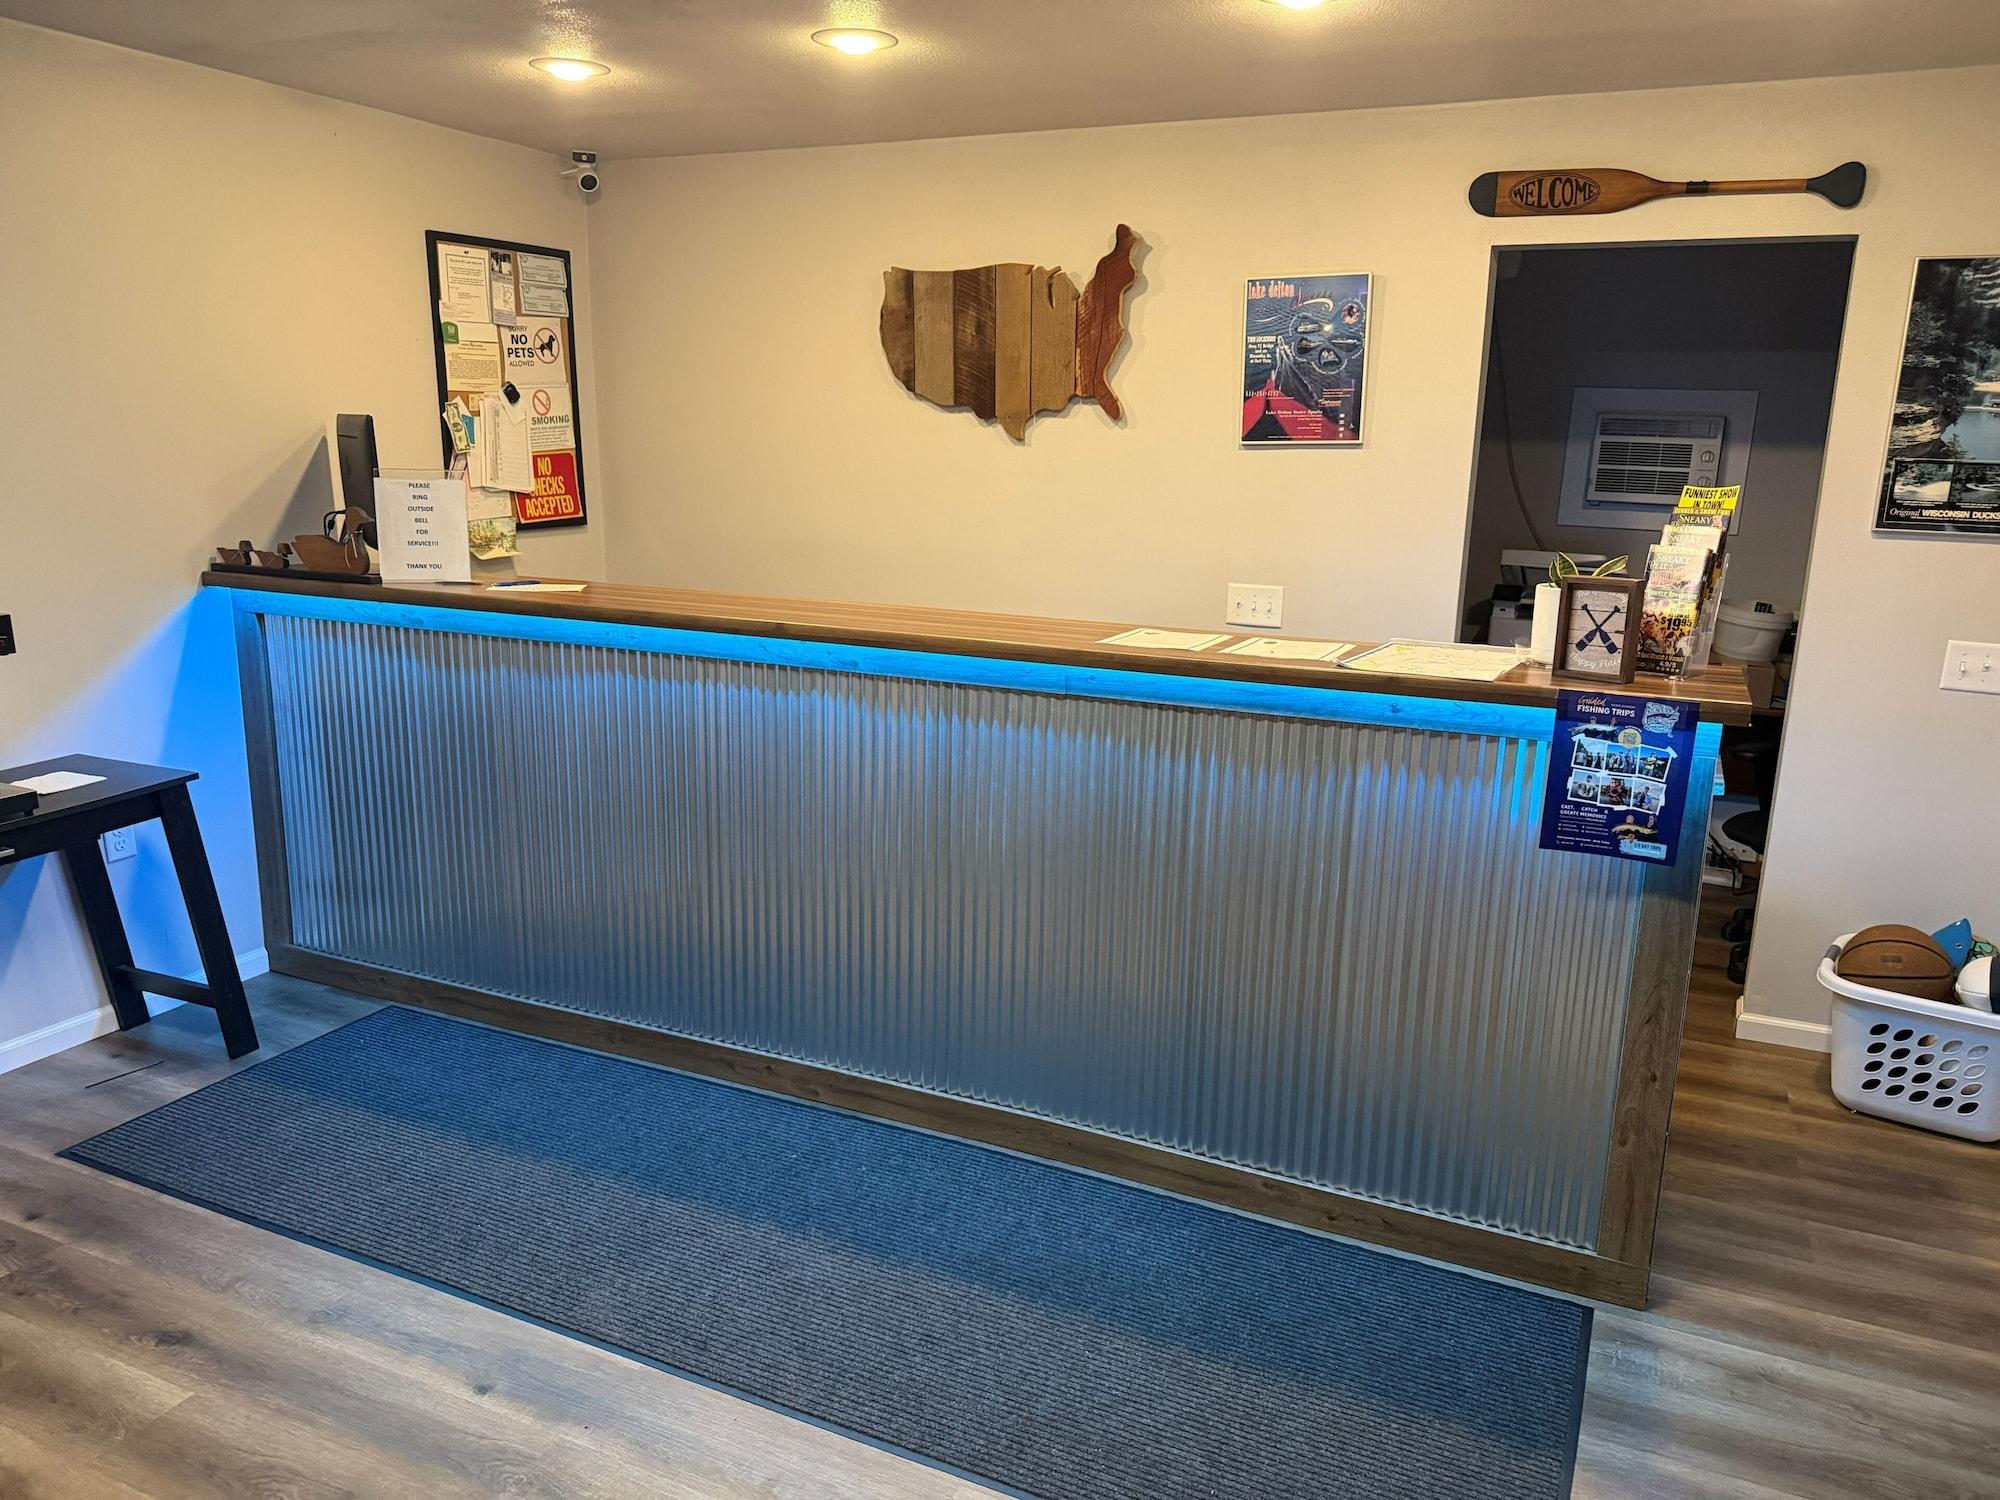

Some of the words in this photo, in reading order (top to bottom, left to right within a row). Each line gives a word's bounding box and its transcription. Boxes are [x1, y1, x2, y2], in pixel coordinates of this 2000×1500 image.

[1513, 177, 1596, 209] WELCOME
[1248, 282, 1266, 299] lake
[1268, 280, 1295, 299] delton
[511, 334, 528, 345] NO
[507, 347, 535, 358] PETS
[531, 414, 570, 426] SMOKING
[537, 456, 552, 476] NO
[1684, 487, 1719, 500] FUNNIEST
[1718, 487, 1739, 500] SHOW
[525, 494, 574, 518] ACCEPTED
[1693, 500, 1701, 508] IN
[1703, 500, 1724, 510] TOWN!
[1677, 513, 1712, 525] SNEAKY
[1889, 508, 1921, 518] Original
[1921, 509, 1970, 519] WISCONSIN
[1656, 552, 1689, 564] SNEAKY
[1577, 695, 1608, 707] Guided
[1577, 704, 1611, 715] FISHING
[1611, 707, 1636, 718] TRIPS
